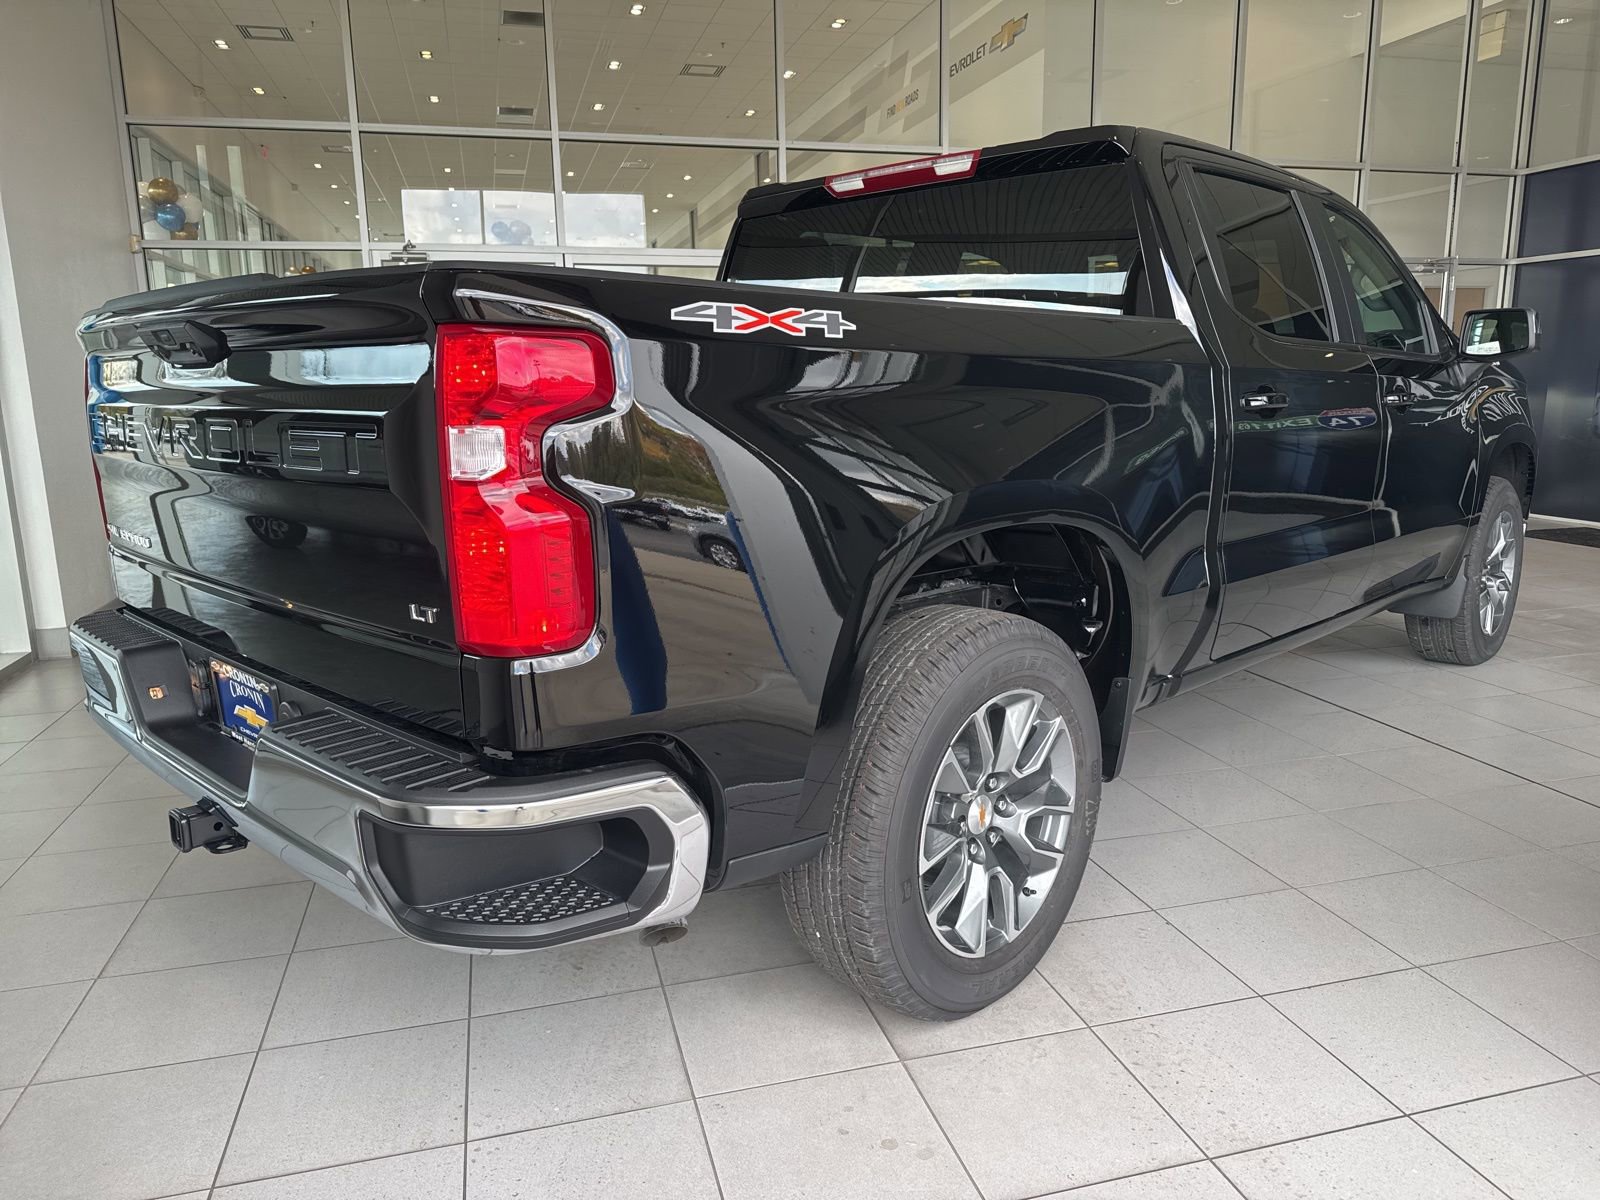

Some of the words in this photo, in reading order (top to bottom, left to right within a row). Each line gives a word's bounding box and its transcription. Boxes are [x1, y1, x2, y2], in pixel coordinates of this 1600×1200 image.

[949, 42, 987, 78] EVROLET
[88, 406, 378, 475] CHEVROLET
[408, 604, 440, 623] LT
[229, 680, 266, 713] CRONIN
